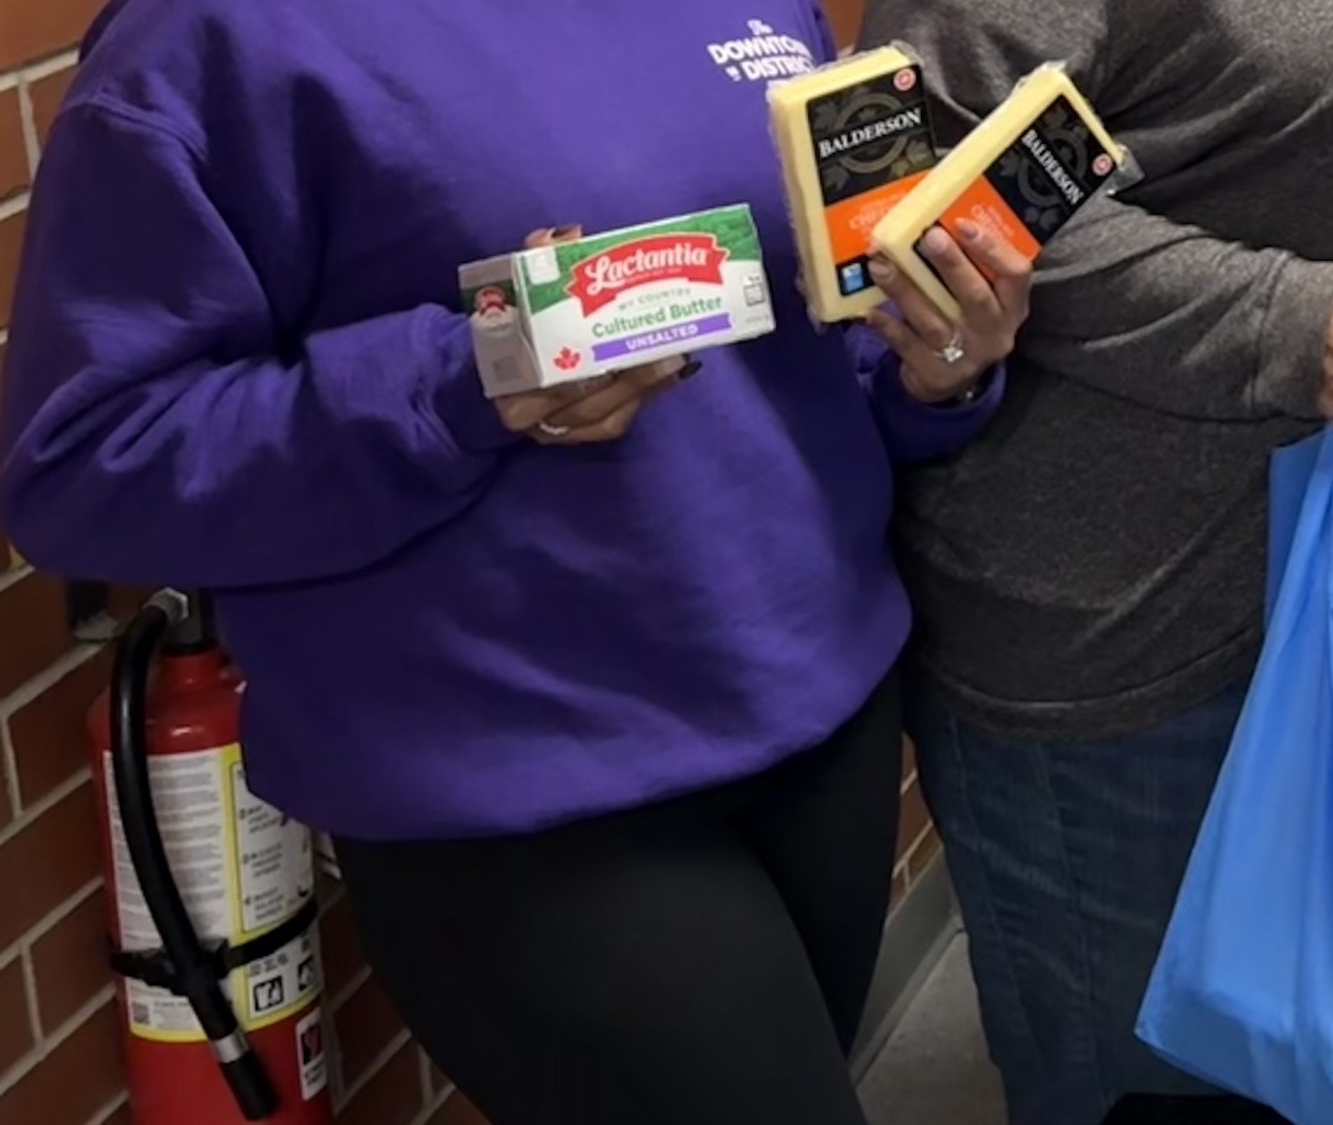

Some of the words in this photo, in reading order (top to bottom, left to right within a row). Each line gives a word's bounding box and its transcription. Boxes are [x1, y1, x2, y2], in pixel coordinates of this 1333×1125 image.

[819, 106, 922, 158] BALDERSON
[1021, 129, 1085, 205] BALDERSON
[585, 243, 707, 296] Lactantia
[592, 308, 667, 338] Cultured
[670, 296, 723, 320] Butter
[625, 324, 699, 351] UNSALTED
